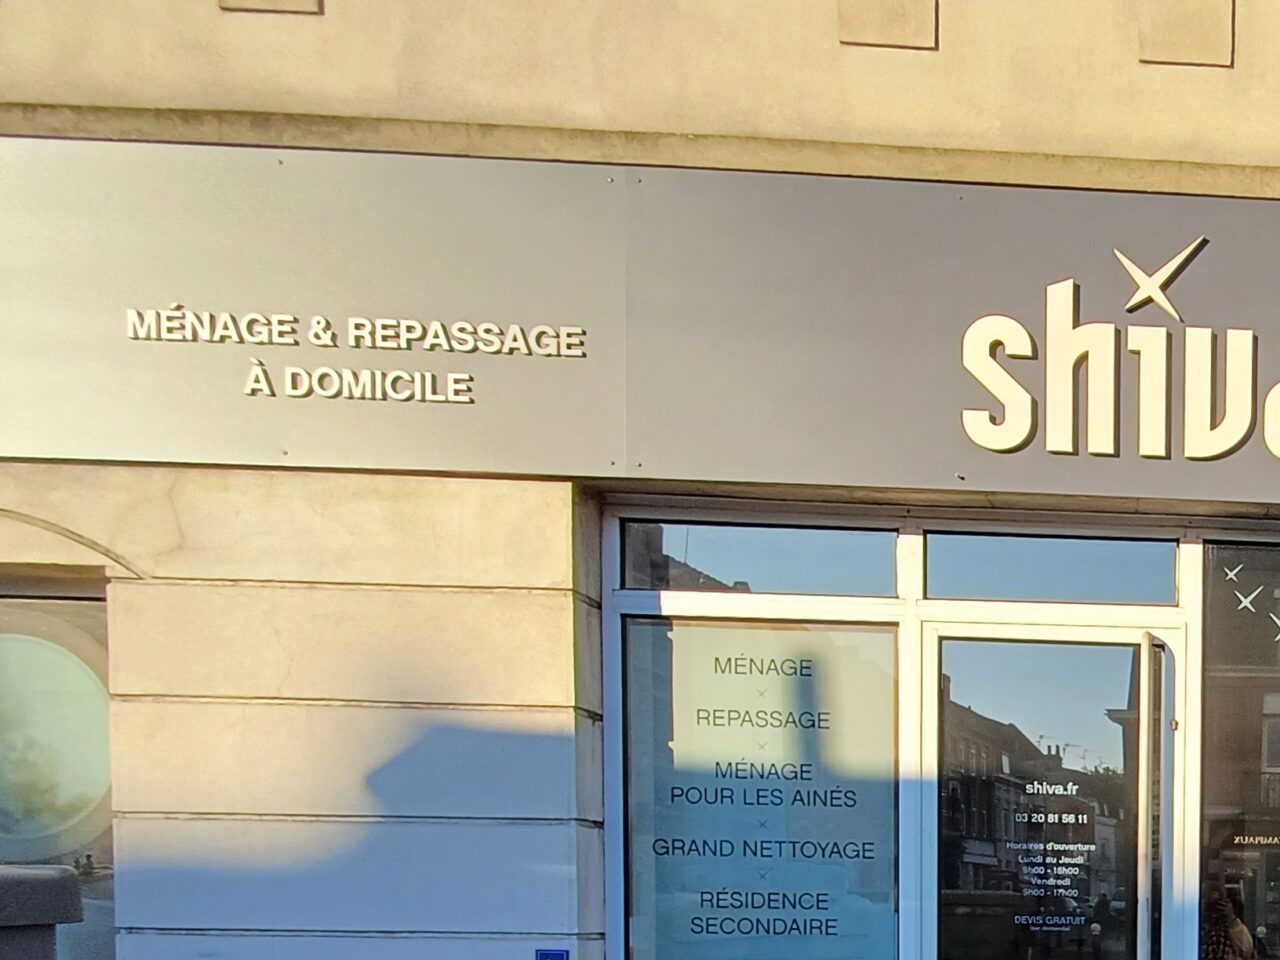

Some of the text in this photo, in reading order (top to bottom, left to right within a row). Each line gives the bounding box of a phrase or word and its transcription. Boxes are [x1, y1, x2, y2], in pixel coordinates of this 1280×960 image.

[126, 303, 586, 358] MÉNAGE & REPASSAGE
[244, 358, 474, 403] À DOMICILE
[714, 653, 813, 677] MÉNAGE
[696, 709, 831, 730] REPASSAGE
[715, 758, 813, 781] MÉNAGE
[670, 785, 857, 808] POUR LES AINÉS
[1025, 780, 1079, 795] shiva.fr
[1015, 813, 1028, 823] 03
[1031, 813, 1045, 823] 20
[1047, 814, 1059, 823] 81
[1077, 814, 1088, 824] 11
[652, 838, 875, 860] GRAND NETTOYAGE
[1006, 842, 1096, 851] Horaires d'ouverture
[1018, 855, 1043, 863] Lundi
[1058, 856, 1084, 864] Jeudi
[1030, 877, 1071, 886] Vendredi
[700, 887, 829, 911] RÉSIDENCE
[690, 916, 838, 936] SECONDAIRE
[1014, 915, 1086, 924] DEVIS GRATUIT
